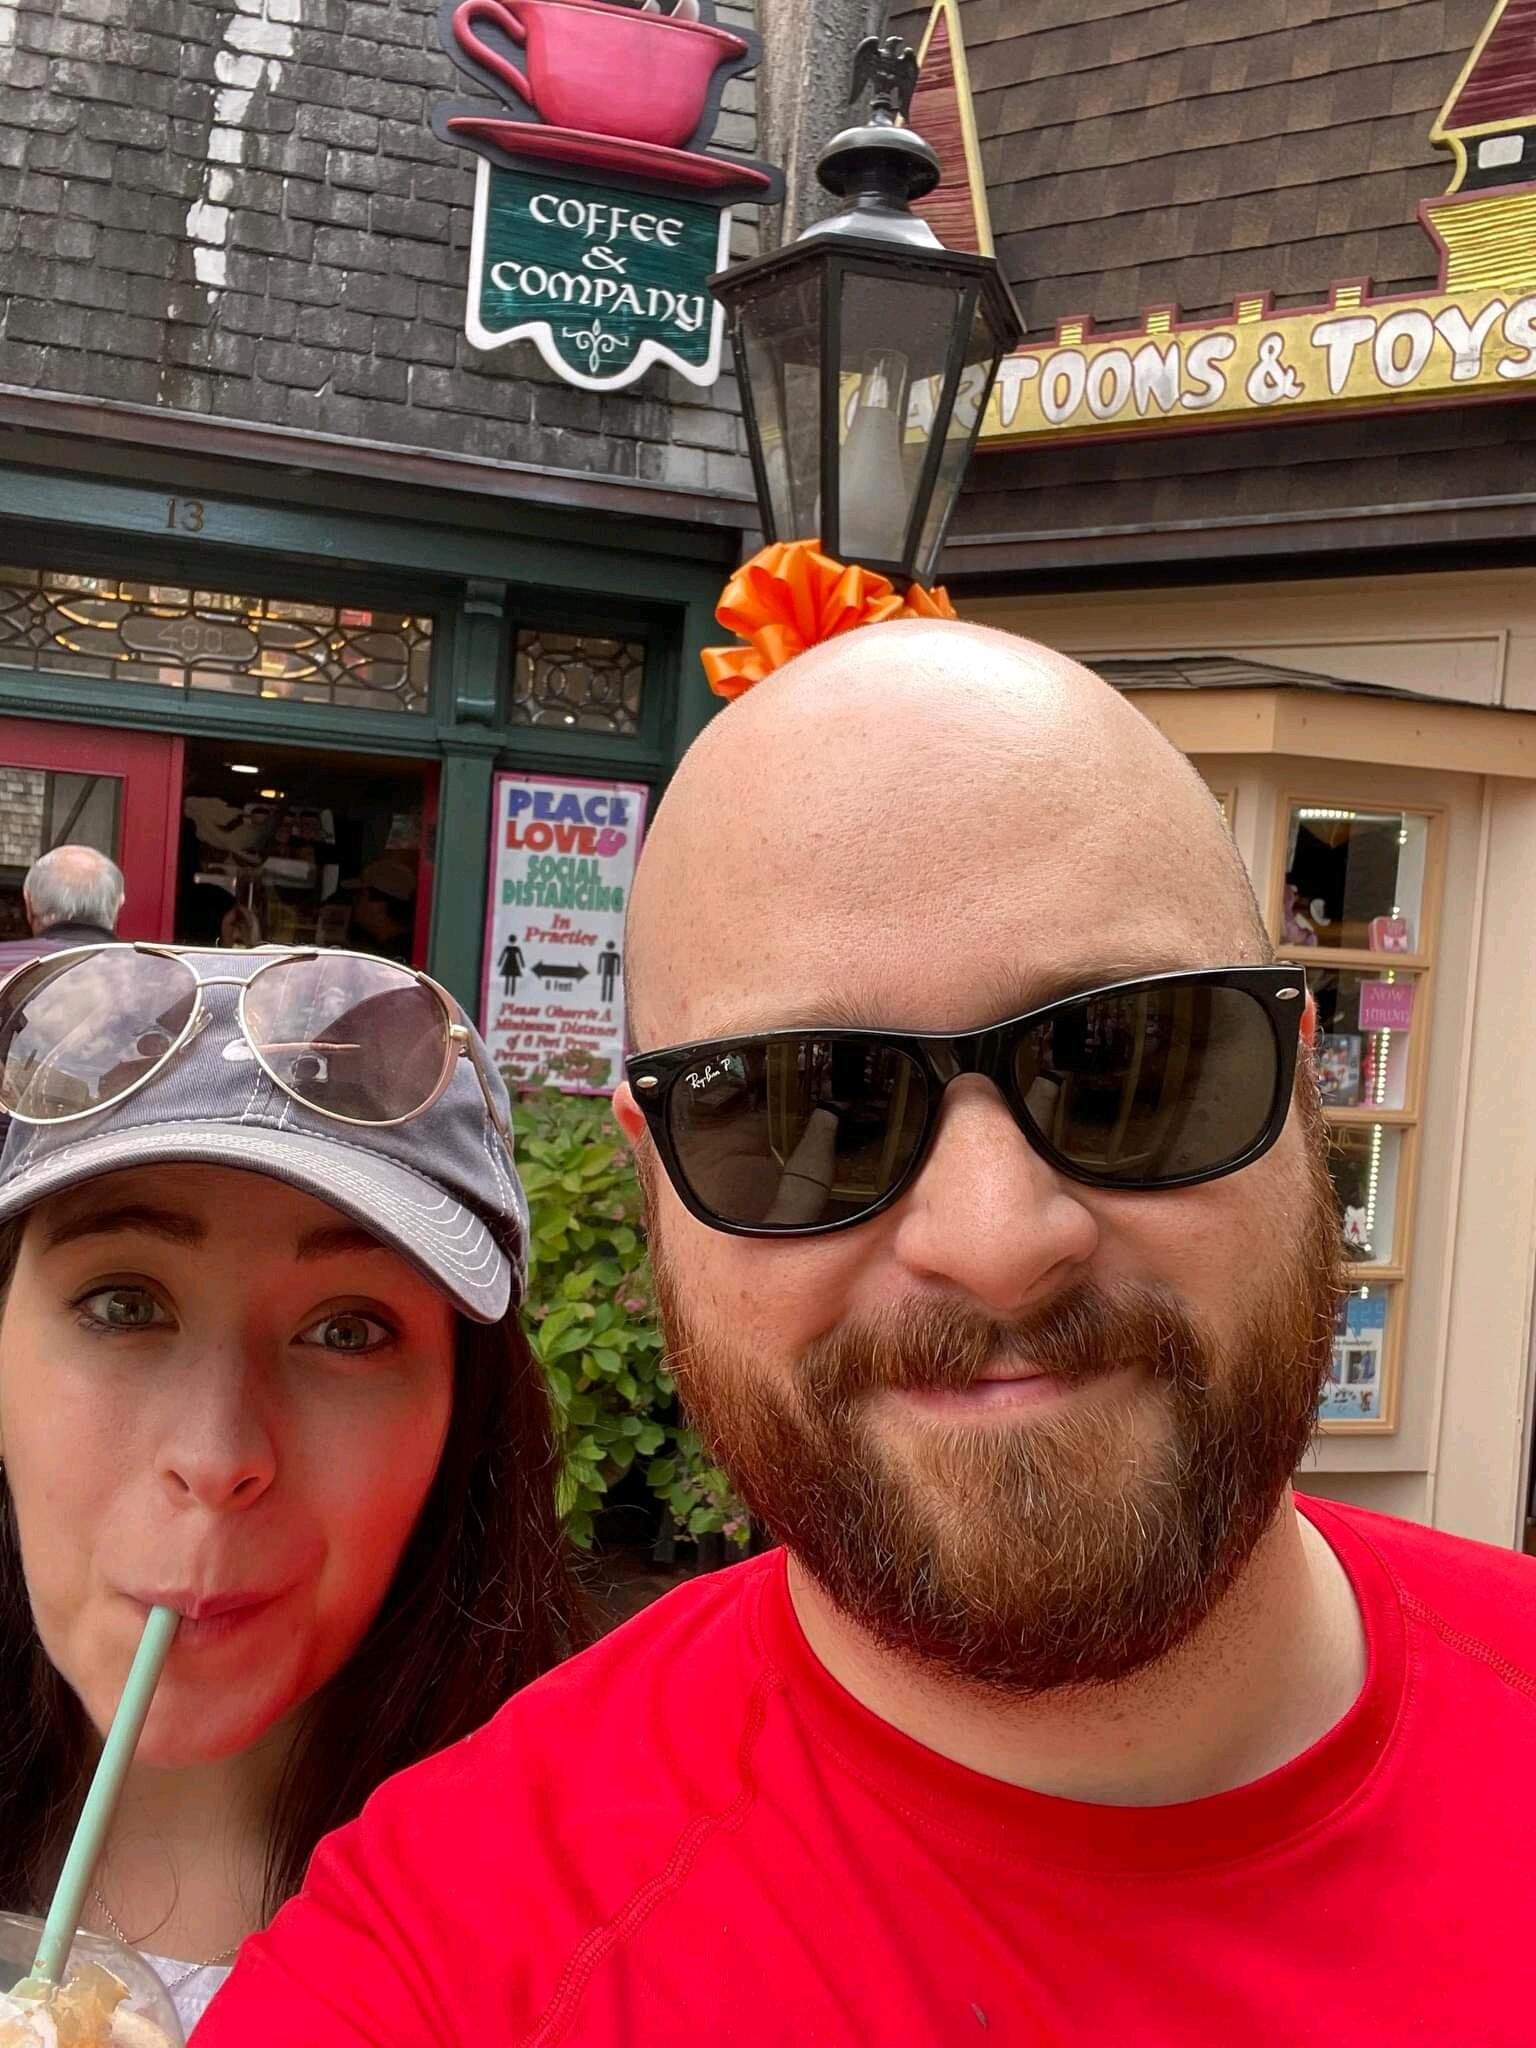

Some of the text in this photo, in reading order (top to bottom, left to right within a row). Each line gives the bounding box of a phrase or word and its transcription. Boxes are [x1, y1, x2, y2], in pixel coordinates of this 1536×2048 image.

[529, 194, 684, 247] COFFEE
[581, 246, 628, 274] &
[490, 261, 704, 332] COMPANY
[1247, 331, 1305, 406] &
[1311, 292, 1536, 396] TOYS
[166, 498, 204, 532] 13
[508, 789, 629, 826] PEACE
[505, 820, 598, 856] LOVE
[527, 855, 602, 884] SOCIAL
[502, 878, 625, 913] DISTANCING
[525, 926, 598, 946] Practice
[552, 913, 571, 929] In
[500, 1003, 540, 1016] Please
[494, 1018, 618, 1036] Minimum Distance
